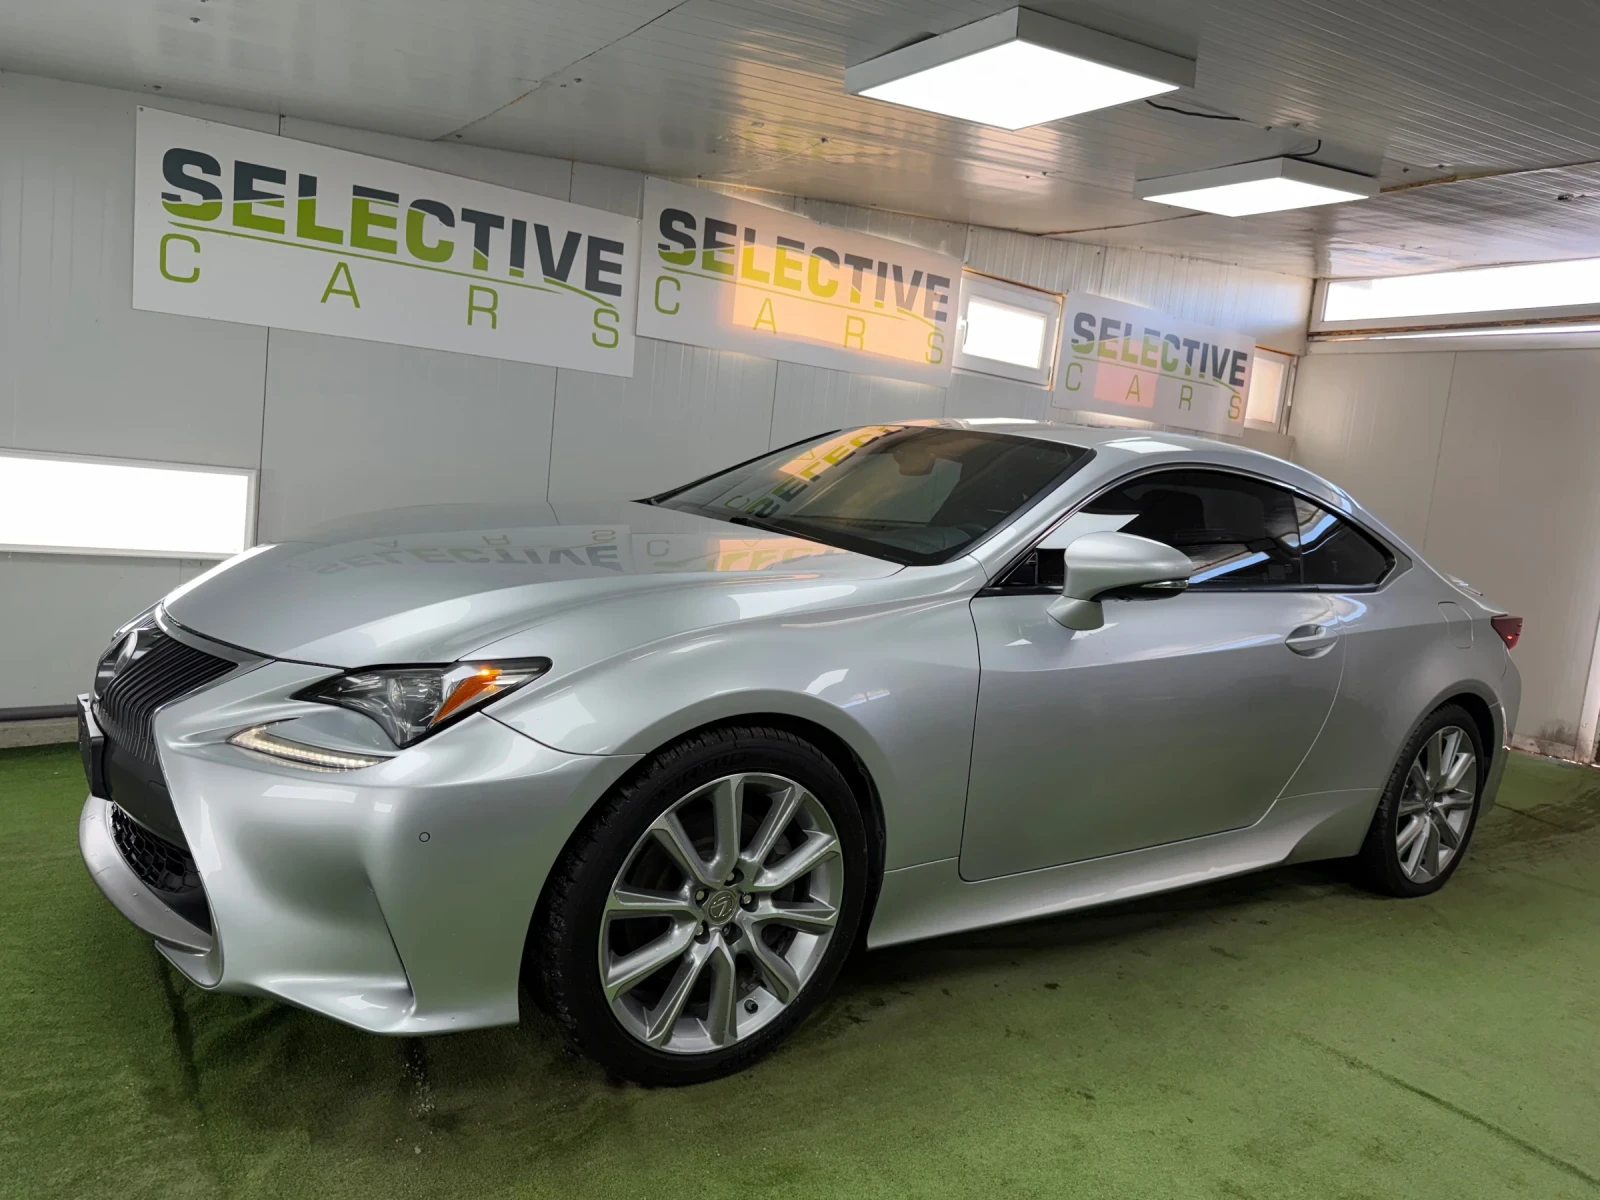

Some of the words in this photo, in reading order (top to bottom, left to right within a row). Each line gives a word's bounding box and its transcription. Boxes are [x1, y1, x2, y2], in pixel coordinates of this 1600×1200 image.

[161, 147, 624, 297] SELECTIVE
[658, 208, 950, 322] SELECTIVE
[159, 233, 620, 348] CARS
[654, 275, 944, 364] CARS
[1065, 362, 1241, 420] CARS
[1071, 312, 1247, 387] SELECTIVE
